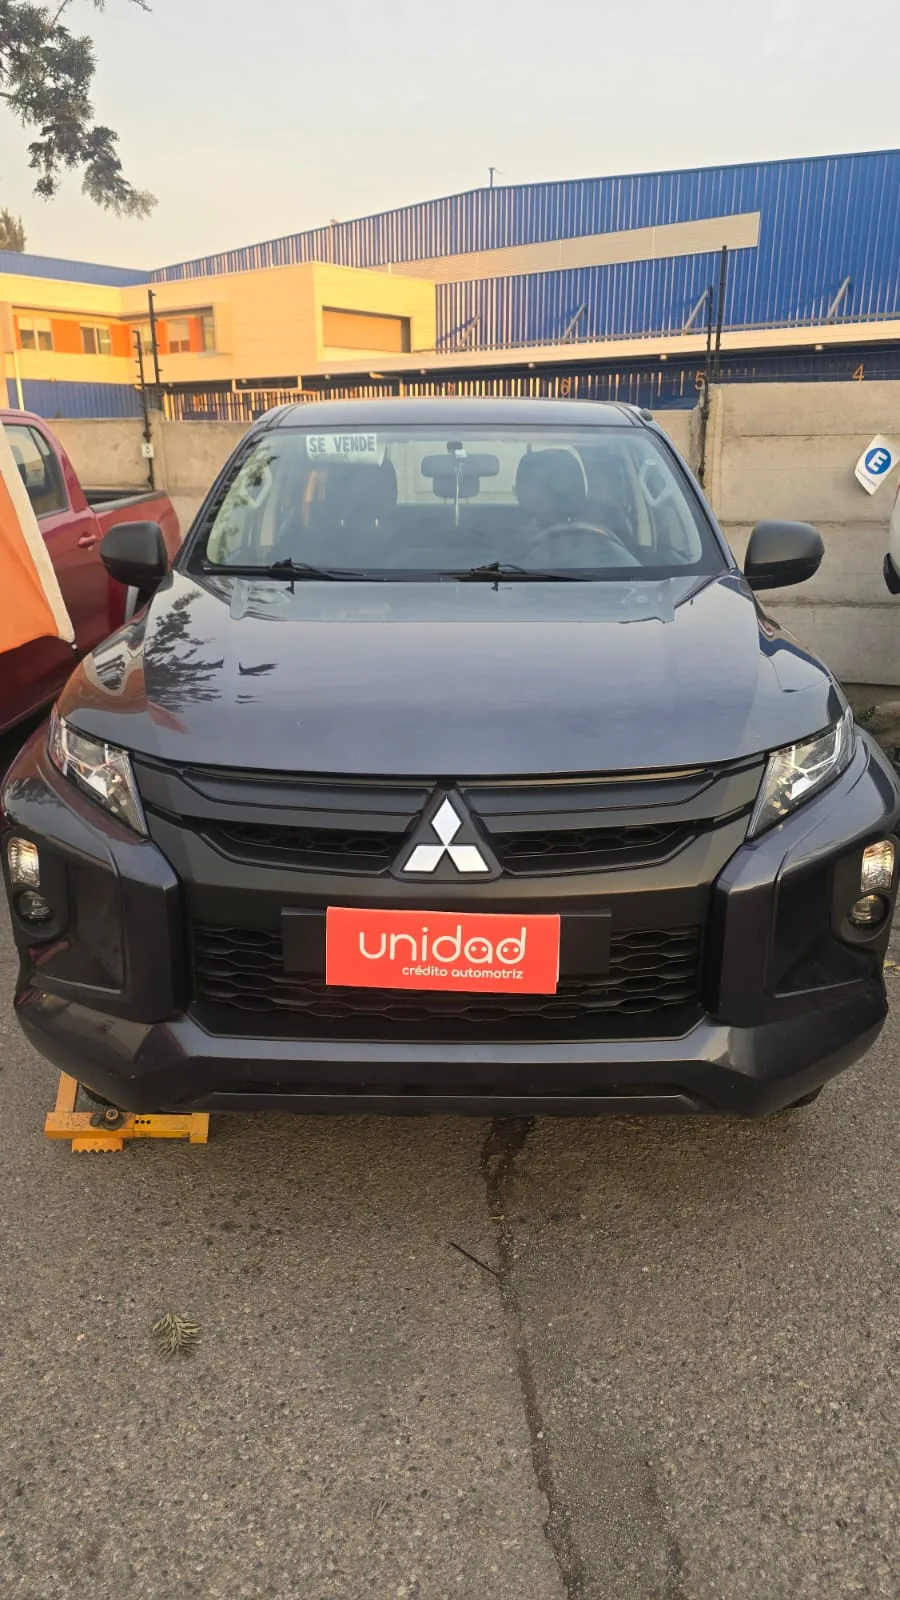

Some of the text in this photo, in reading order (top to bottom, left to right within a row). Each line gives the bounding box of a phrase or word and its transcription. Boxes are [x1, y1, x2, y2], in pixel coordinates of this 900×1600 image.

[309, 435, 375, 453] SE VENDE
[867, 450, 888, 473] E
[359, 925, 527, 965] unidad
[402, 965, 524, 980] crédito automotriz
